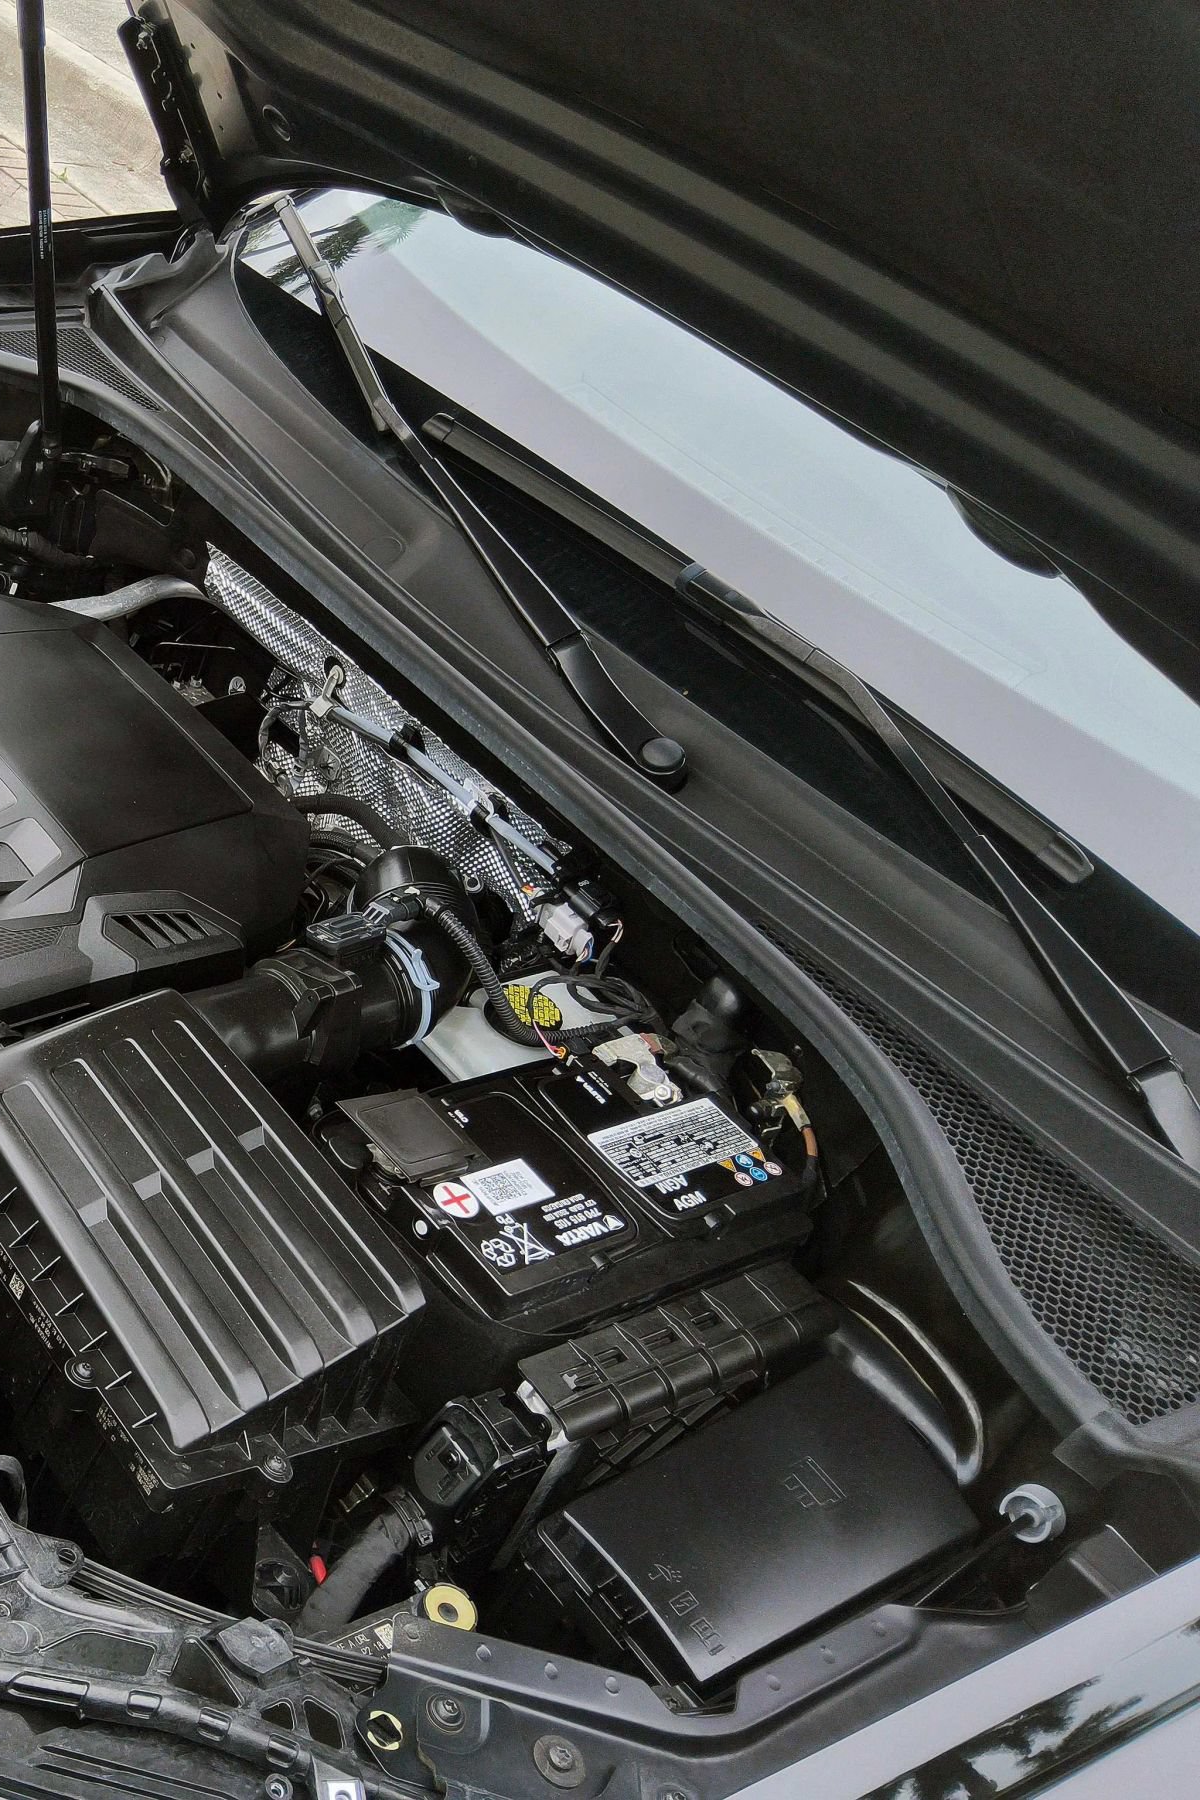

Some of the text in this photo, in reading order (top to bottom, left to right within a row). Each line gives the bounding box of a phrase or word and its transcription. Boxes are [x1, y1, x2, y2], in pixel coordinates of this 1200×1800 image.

[655, 1175, 689, 1194] AGM
[673, 1190, 707, 1211] AGM
[553, 1217, 571, 1229] 105
[568, 1212, 586, 1224] 915
[555, 1221, 607, 1245] VARTA
[355, 1633, 371, 1644] DRL
